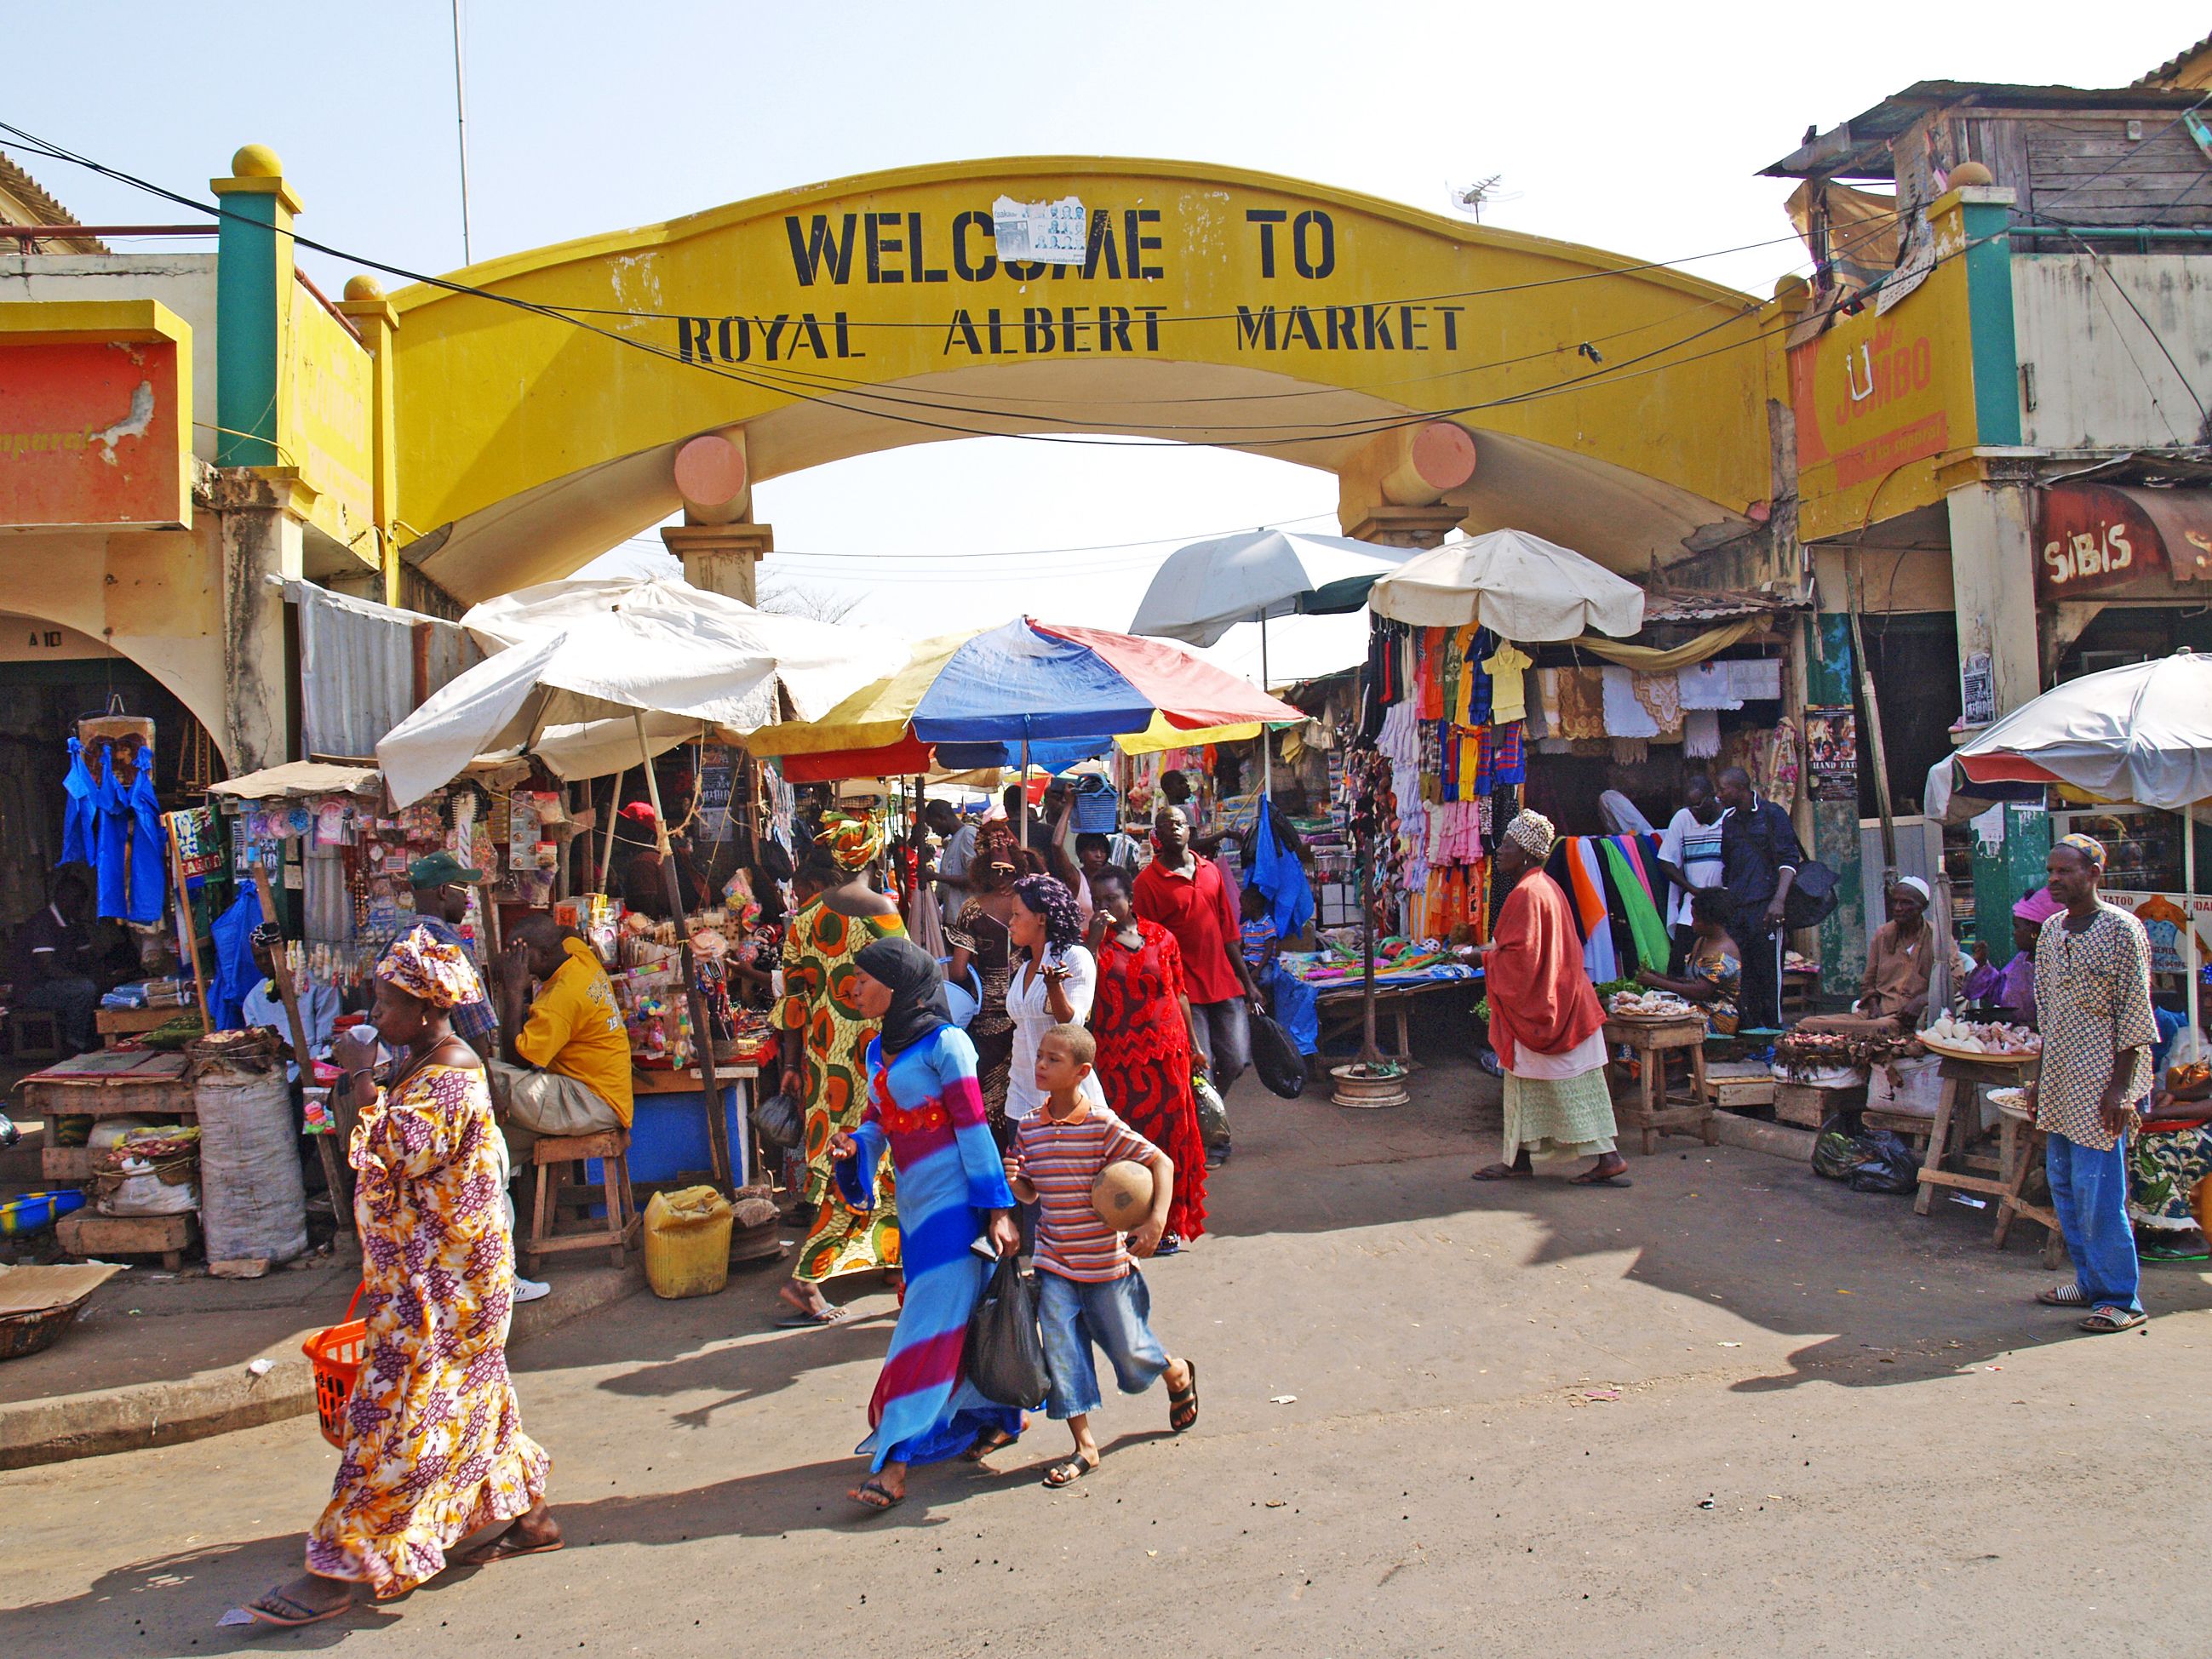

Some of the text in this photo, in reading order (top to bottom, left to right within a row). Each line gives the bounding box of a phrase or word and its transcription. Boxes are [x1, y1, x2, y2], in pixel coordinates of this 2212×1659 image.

[785, 209, 1335, 286] WELCME TO
[678, 305, 1465, 363] ROYAL ALBERT MARKET
[1836, 336, 1931, 426] JUMBO
